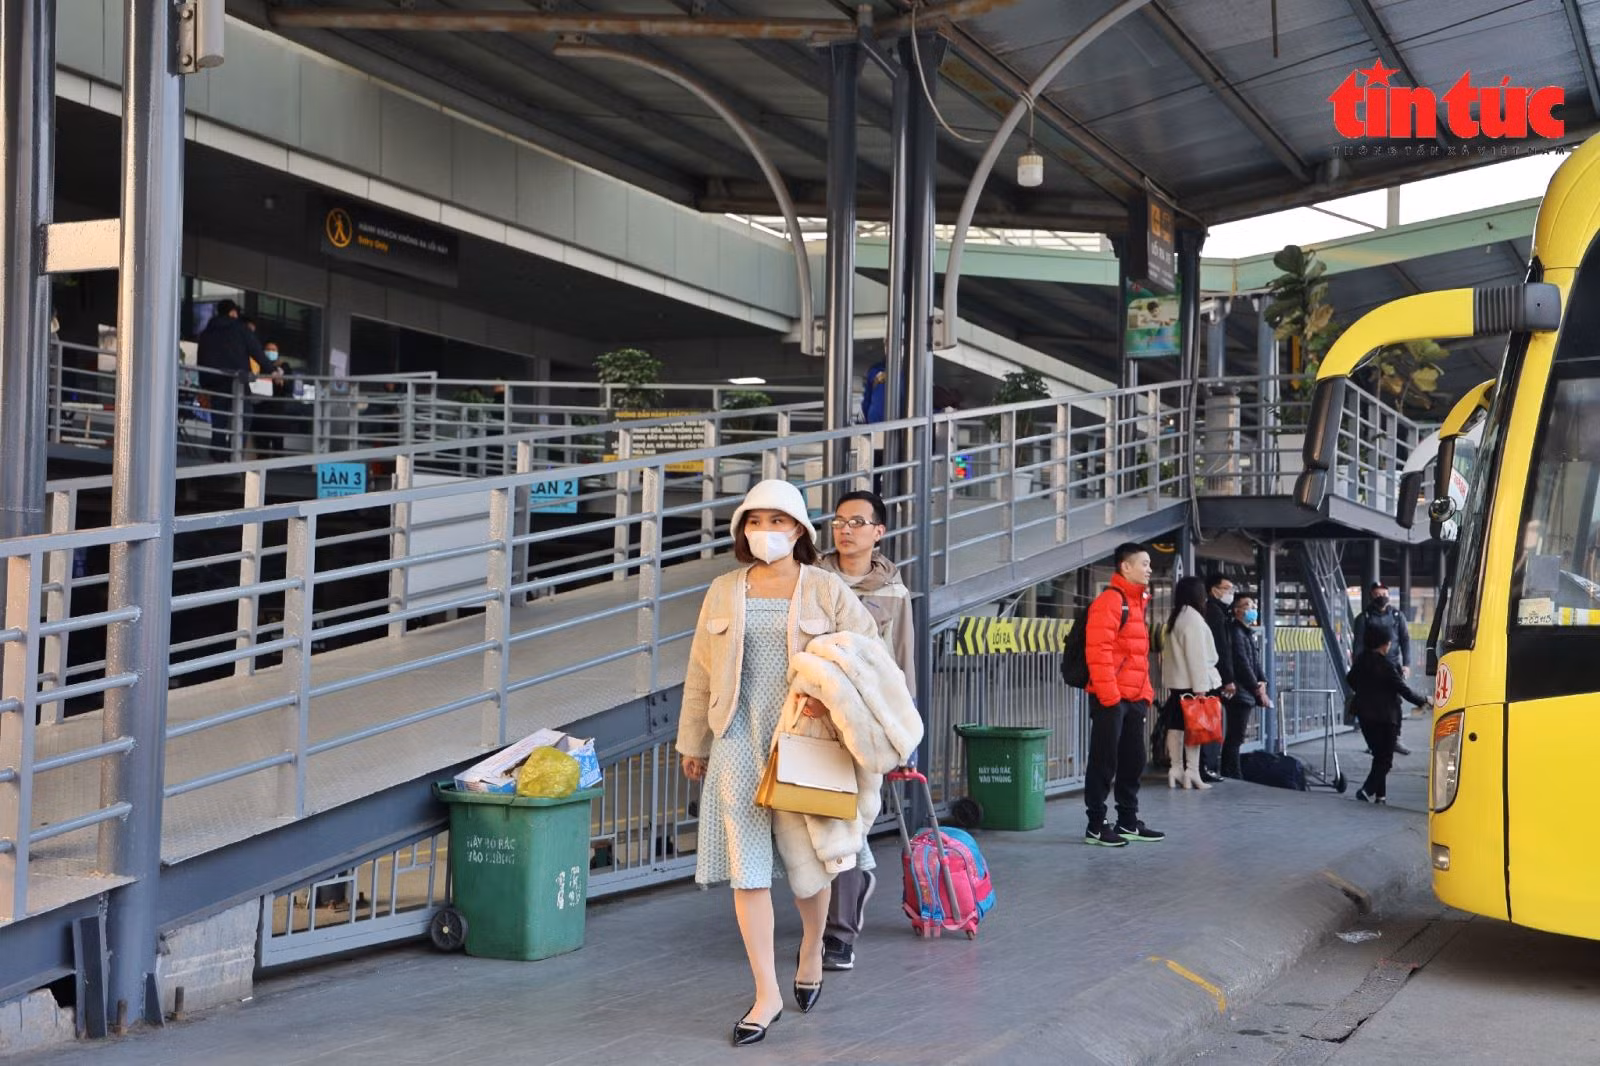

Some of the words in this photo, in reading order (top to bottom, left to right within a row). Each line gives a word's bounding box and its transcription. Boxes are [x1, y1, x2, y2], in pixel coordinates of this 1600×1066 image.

[321, 466, 349, 485] LÀN
[353, 471, 362, 486] 3
[564, 480, 573, 494] 2
